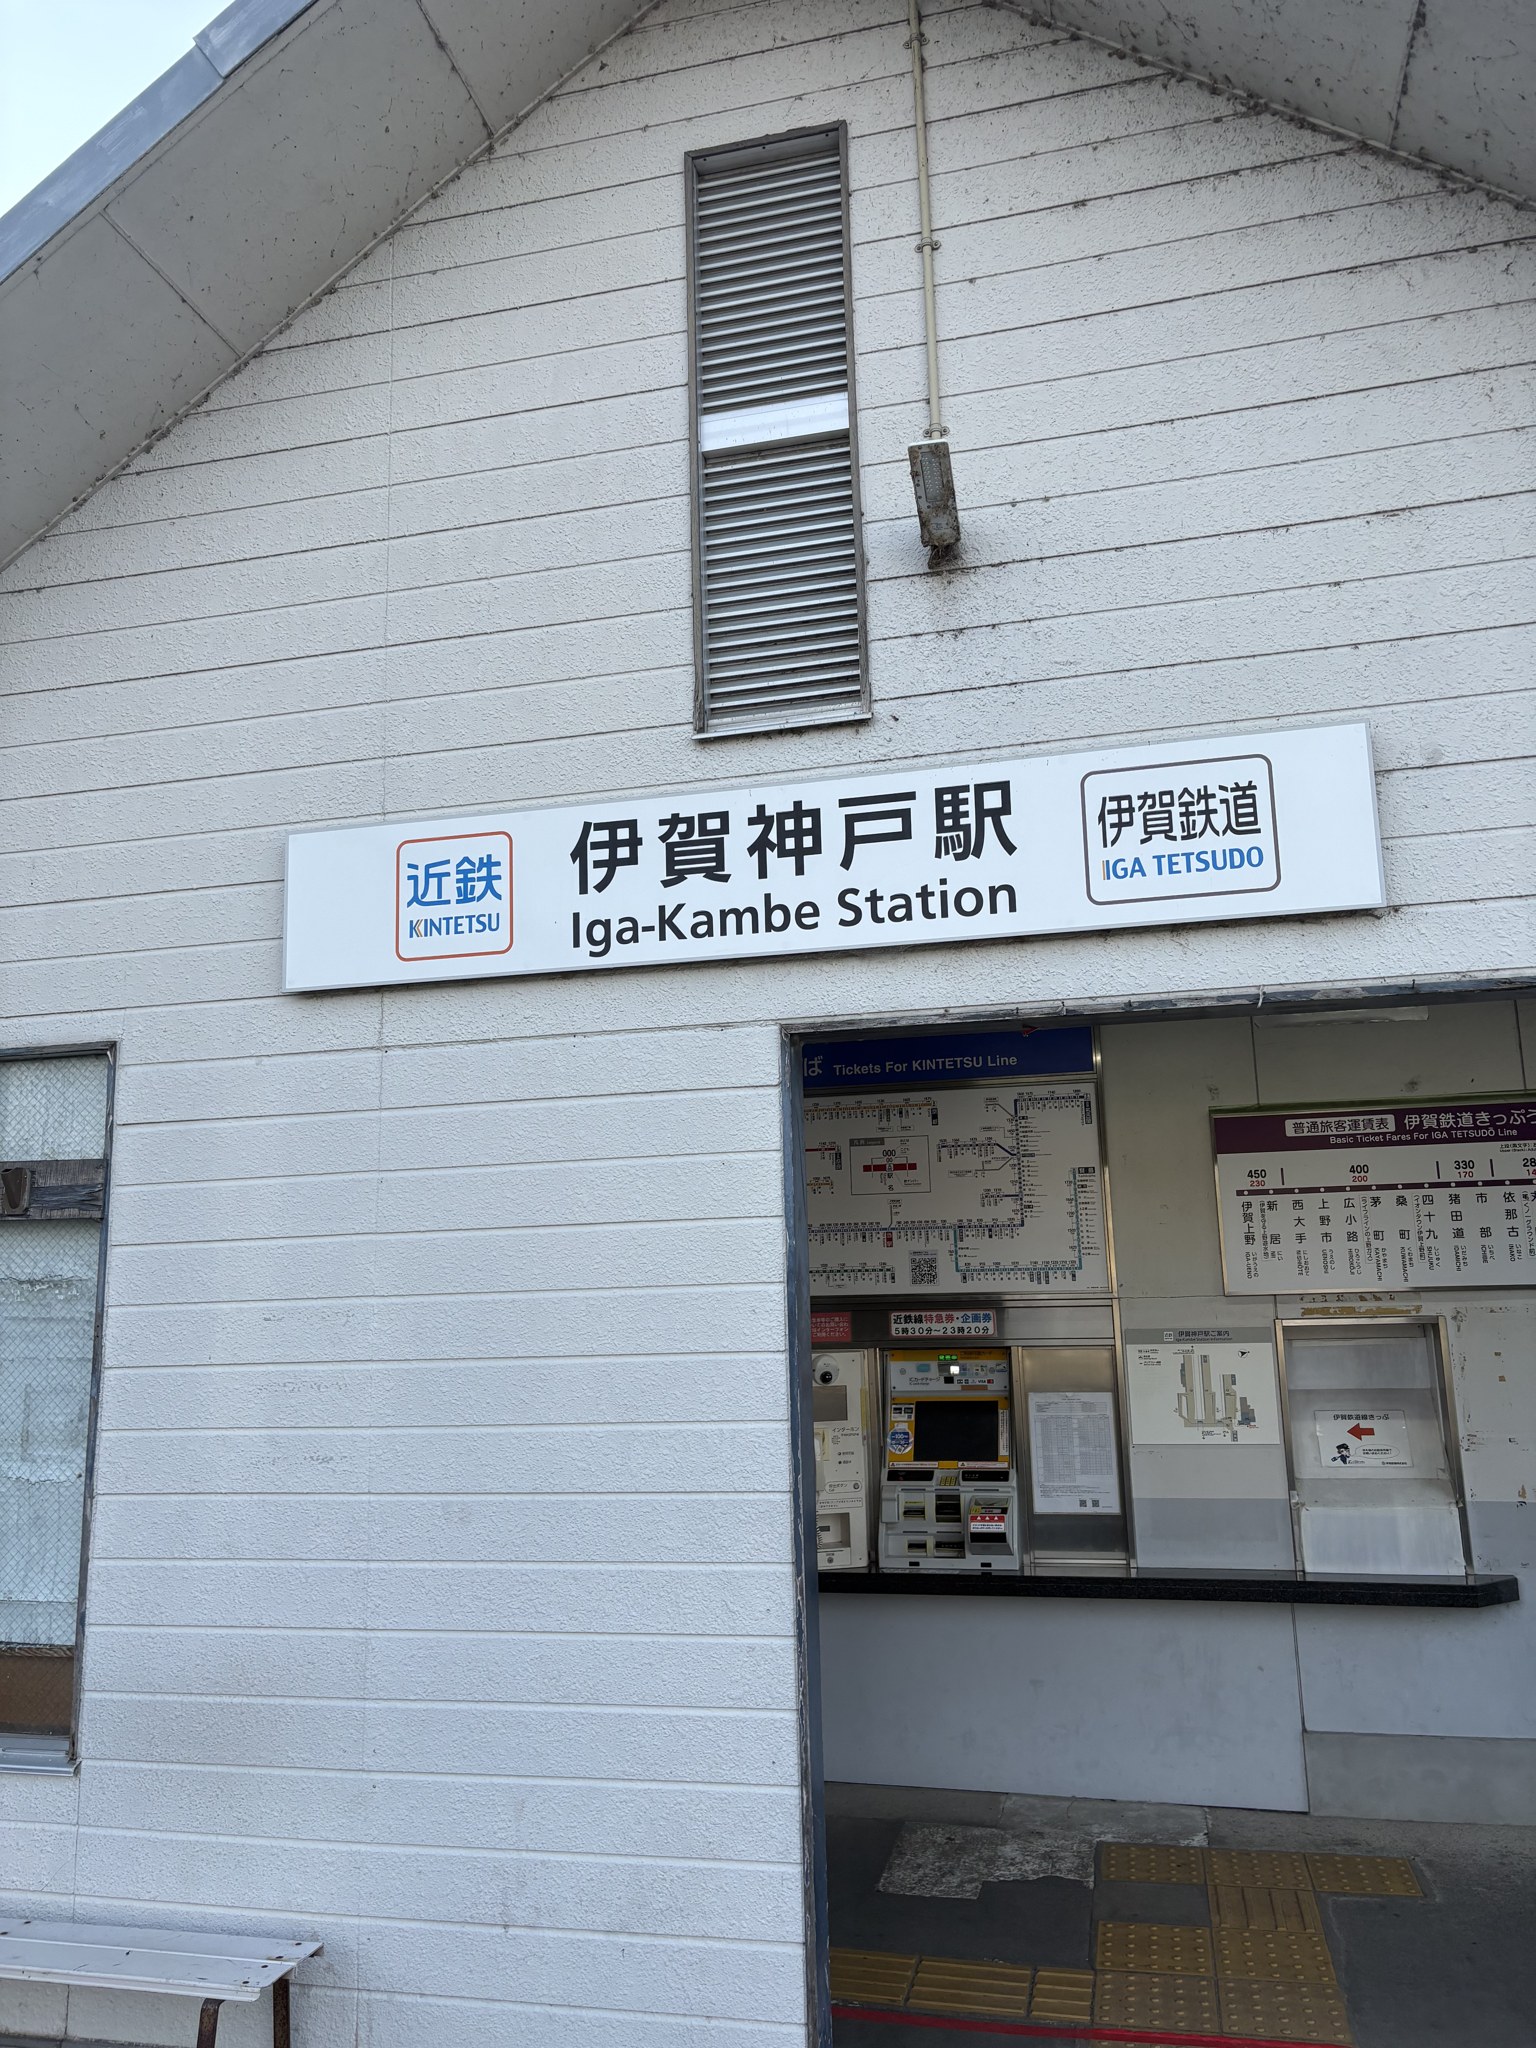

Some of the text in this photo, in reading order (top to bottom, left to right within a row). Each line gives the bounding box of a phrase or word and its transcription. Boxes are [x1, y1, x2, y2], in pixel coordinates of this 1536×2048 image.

[1097, 780, 1262, 849] 伊賀鉄道
[570, 779, 1018, 896] 伊賀神戸駅
[406, 854, 503, 908] 近鉄
[1102, 846, 1264, 881] IGA TETSUDO
[408, 912, 501, 939] KINTETSU
[572, 878, 1017, 958] Iga-Kambe Station
[833, 1055, 1018, 1076] Tickets For KINTETSU Line
[1292, 1117, 1390, 1134] 普通旅客運賃表
[1329, 1135, 1354, 1145] Basic
[1356, 1133, 1384, 1144] Ticket
[1386, 1132, 1411, 1142] Fares
[1413, 1131, 1428, 1141] For
[1431, 1129, 1449, 1139] IGA
[1498, 1127, 1518, 1137] Line
[1247, 1169, 1267, 1179] 450
[1249, 1180, 1266, 1188] 230
[1349, 1164, 1370, 1174] 400
[1352, 1175, 1368, 1183] 200
[1454, 1160, 1475, 1170] 330
[1458, 1171, 1473, 1179] 170
[1241, 1200, 1256, 1246] 伊賀上野
[1266, 1200, 1282, 1245] 新居
[1291, 1199, 1307, 1245] 西大手
[1317, 1198, 1333, 1243] 上野市
[1343, 1197, 1359, 1242] 広小路
[1369, 1196, 1385, 1242] 茅町
[1395, 1195, 1411, 1241] 桑町
[1422, 1194, 1439, 1240] 四十九
[1448, 1193, 1465, 1239] 猪田道
[1475, 1192, 1492, 1239] 市部
[1502, 1191, 1520, 1238] 依那古
[1374, 1247, 1383, 1282] KAYAMACHI
[892, 1312, 993, 1325] 近鉄線特急券・企画券
